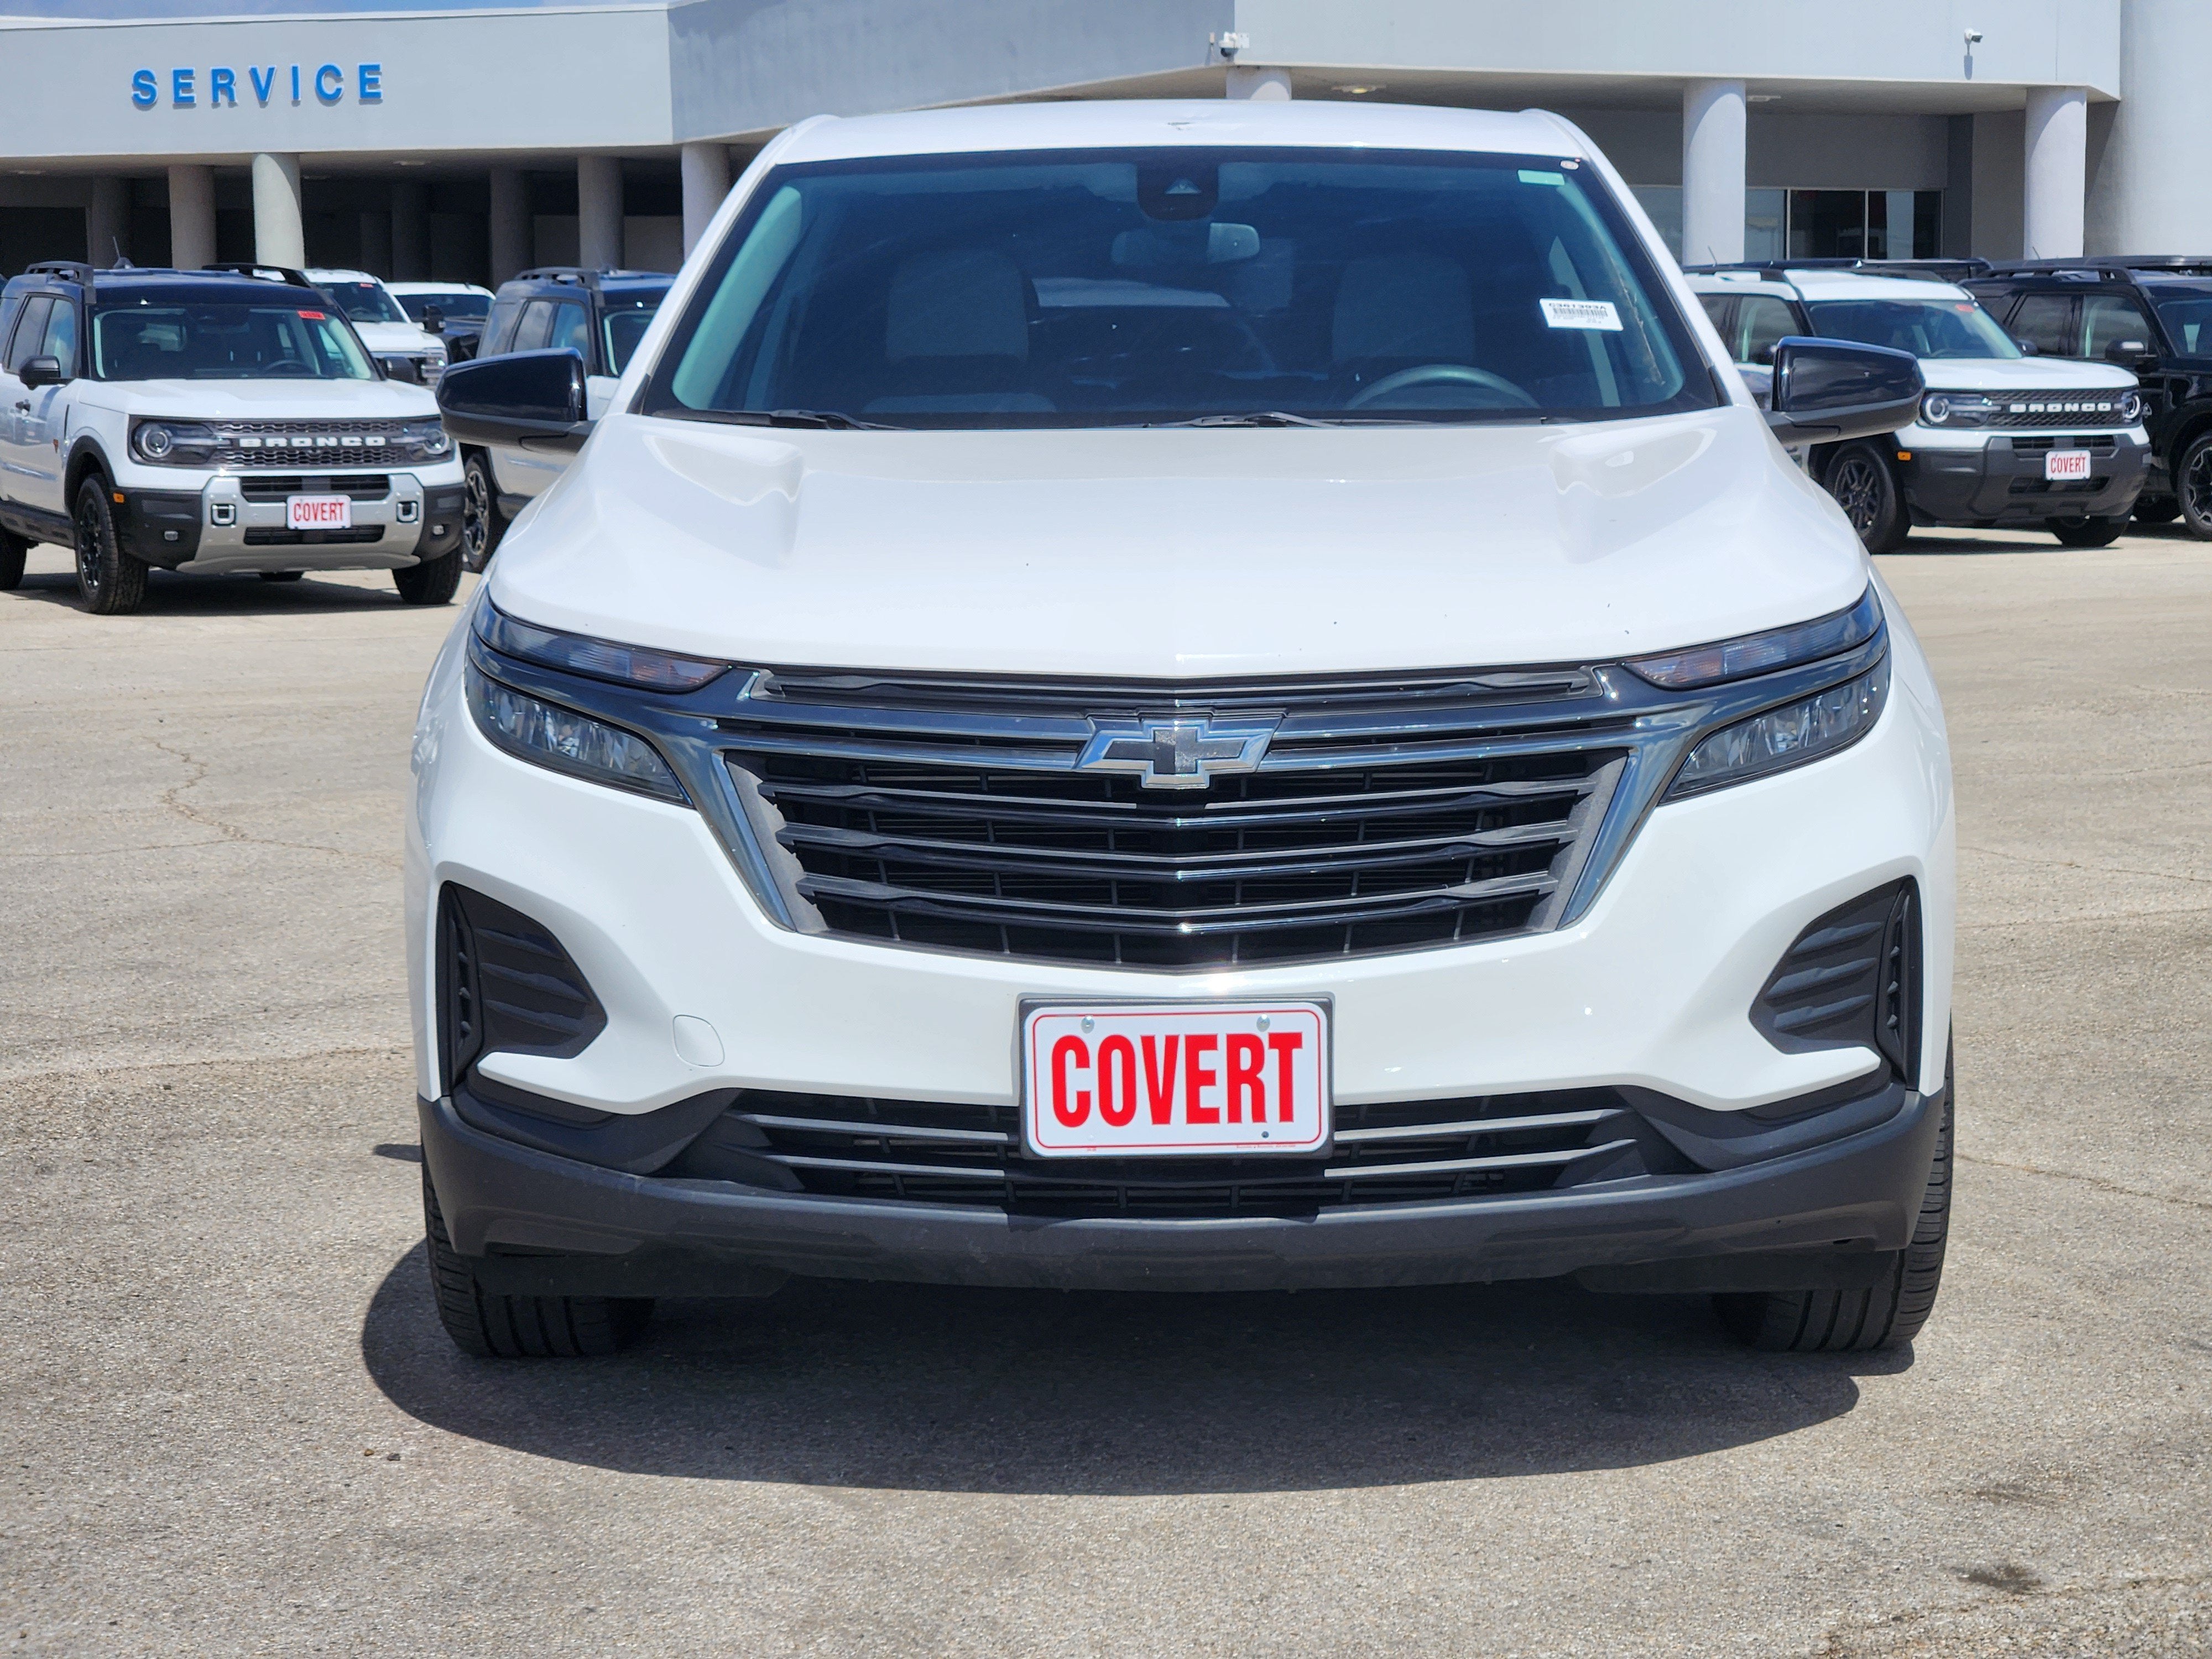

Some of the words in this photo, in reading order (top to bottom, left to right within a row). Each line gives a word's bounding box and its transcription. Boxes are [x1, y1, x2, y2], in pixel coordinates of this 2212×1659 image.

[132, 62, 383, 106] SERVICE
[2010, 403, 2111, 413] BRONCO
[239, 437, 386, 447] BRONCO
[2051, 456, 2086, 473] COVERT
[294, 503, 344, 521] COVERT
[1051, 1032, 1303, 1127] COVERT
